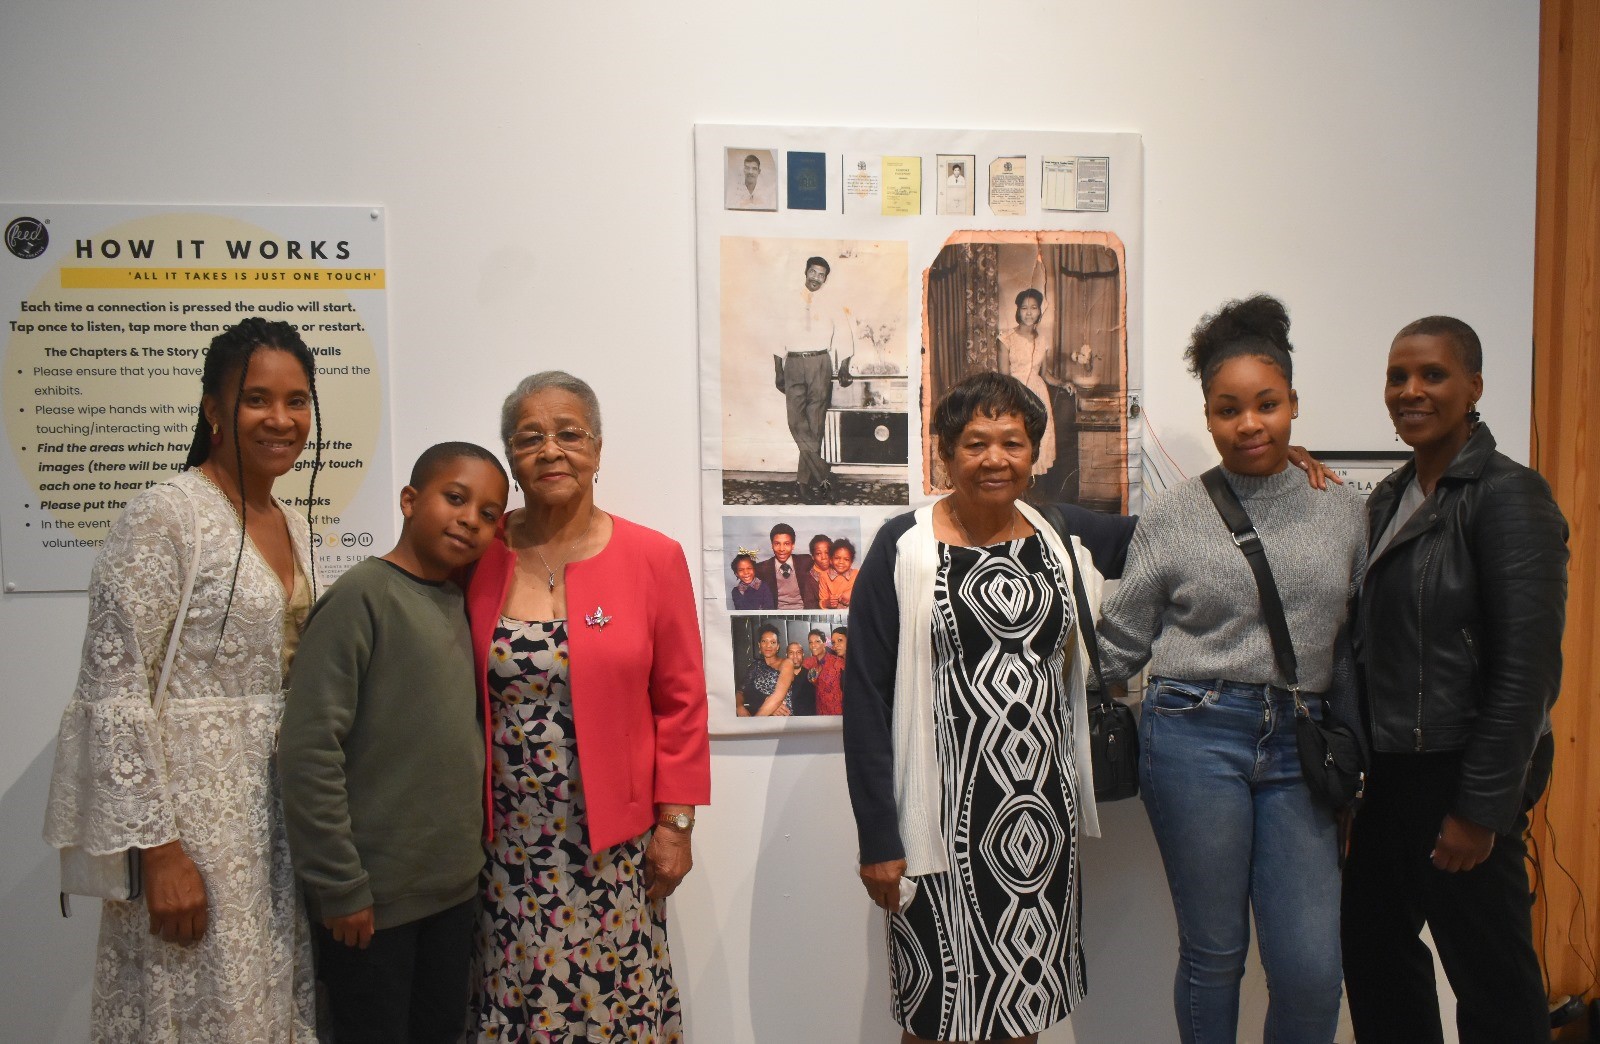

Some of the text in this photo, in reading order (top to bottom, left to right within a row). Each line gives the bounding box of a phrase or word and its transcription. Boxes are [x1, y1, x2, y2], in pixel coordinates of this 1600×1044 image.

[11, 222, 42, 247] feed
[76, 239, 350, 260] HOW IT WORKS
[165, 272, 177, 280] IT
[185, 272, 227, 281] TAKES
[235, 272, 248, 281] IS
[254, 272, 286, 281] JUST
[293, 272, 320, 281] ONE
[21, 300, 356, 315] Each time a connection is pressed the audio will start.
[9, 321, 35, 334] Tap
[37, 323, 68, 332] once
[70, 322, 84, 332] to
[87, 320, 126, 334] listen,
[128, 322, 151, 334] tap
[153, 323, 187, 332] more
[190, 320, 220, 332] than
[301, 323, 315, 332] or
[318, 322, 365, 332] restart.
[45, 347, 67, 357] The
[69, 347, 128, 359] Chapters
[130, 347, 139, 357] &
[142, 347, 165, 357] The
[167, 347, 199, 359] Story
[308, 346, 341, 356] Walls
[33, 365, 371, 378] Please ensure that you have round the
[34, 385, 83, 396] exhibits.
[35, 403, 201, 417] Please wipe hands with wip
[36, 421, 160, 437] touching/interacting
[164, 422, 188, 433] with
[37, 443, 64, 453] Find
[66, 443, 87, 453] the
[89, 444, 125, 453] areas
[128, 441, 165, 452] which
[167, 442, 192, 452] hav
[319, 441, 331, 450] of
[333, 441, 353, 450] the
[38, 462, 85, 475] images
[88, 459, 126, 474] (there
[129, 461, 150, 471] will
[152, 461, 168, 471] be
[170, 462, 187, 474] up
[328, 459, 363, 469] touch
[39, 480, 158, 491] each one to hear th
[40, 500, 81, 510] Please
[83, 500, 105, 512] put
[107, 499, 127, 509] the
[294, 496, 331, 506] hooks
[41, 514, 341, 529] In the event of the
[42, 539, 104, 548] volunteers
